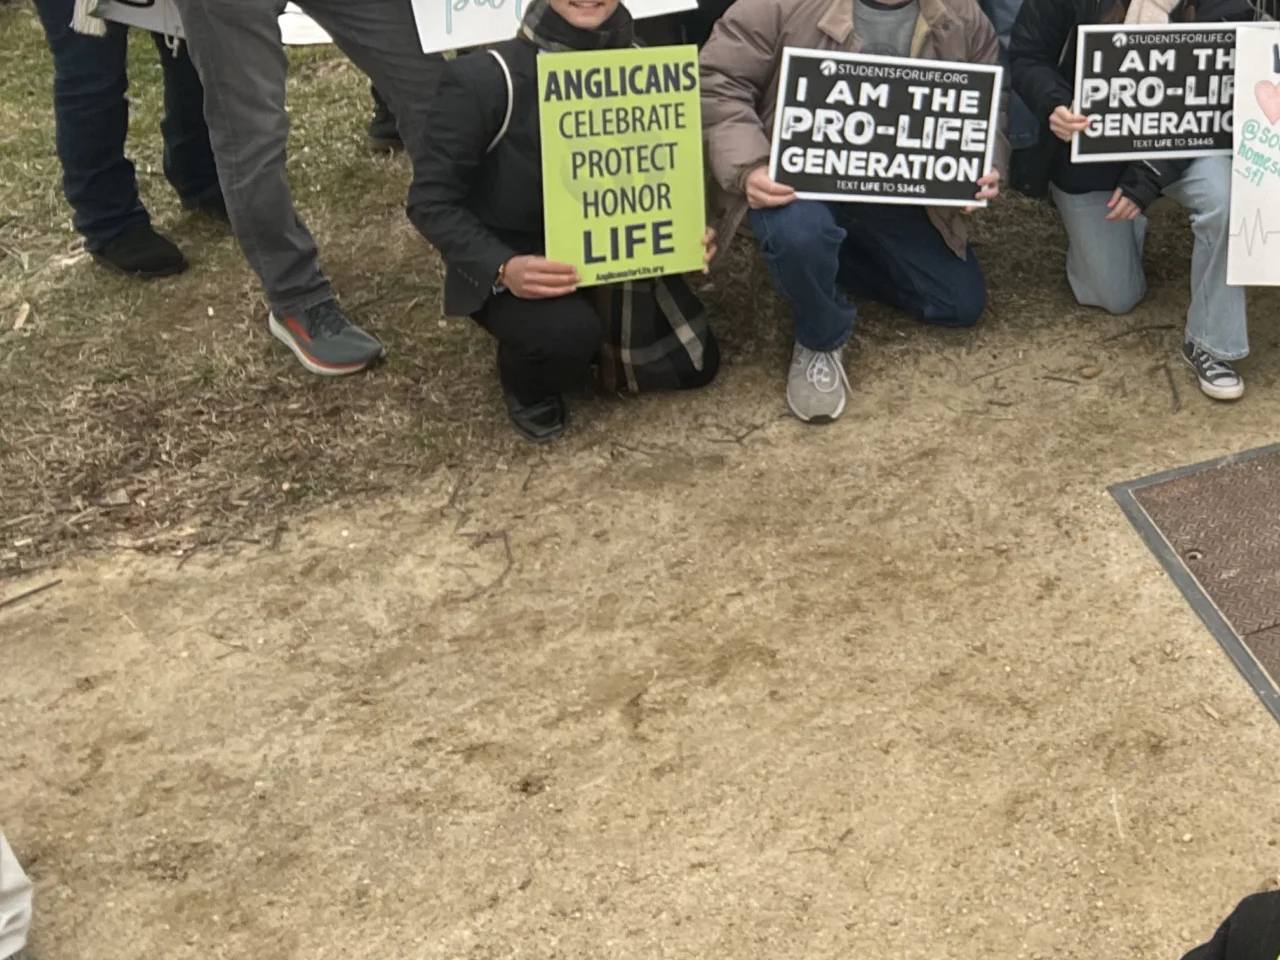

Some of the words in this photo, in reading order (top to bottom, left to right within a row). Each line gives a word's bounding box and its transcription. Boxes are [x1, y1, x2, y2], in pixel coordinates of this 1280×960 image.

[1128, 33, 1236, 45] STUDENTSFORLIFE.O
[837, 63, 969, 84] STUDENTSFORLIFE.ORG
[1093, 50, 1102, 73] I
[1118, 48, 1176, 73] AM
[1192, 47, 1235, 70] TH
[543, 61, 698, 102] ANGLICANS
[796, 76, 808, 102] I
[825, 80, 890, 108] AM
[907, 86, 981, 115] THE
[1081, 74, 1236, 109] PRO-LIF
[559, 102, 687, 139] CELEBRATE
[780, 106, 989, 153] PRO-LIFE
[1083, 110, 1234, 138] GENERATIO
[1132, 139, 1152, 148] TEXT
[1154, 138, 1172, 147] LIFE
[1174, 138, 1186, 146] TO
[1187, 137, 1214, 146] 53445
[571, 142, 678, 180] PROTECT
[781, 146, 980, 182] GENERATION
[582, 183, 672, 219] HONOR
[836, 179, 858, 190] TEXT
[860, 180, 880, 192] LIFE
[882, 181, 895, 192] TO
[897, 182, 926, 193] 53445
[583, 220, 675, 265] LIFE
